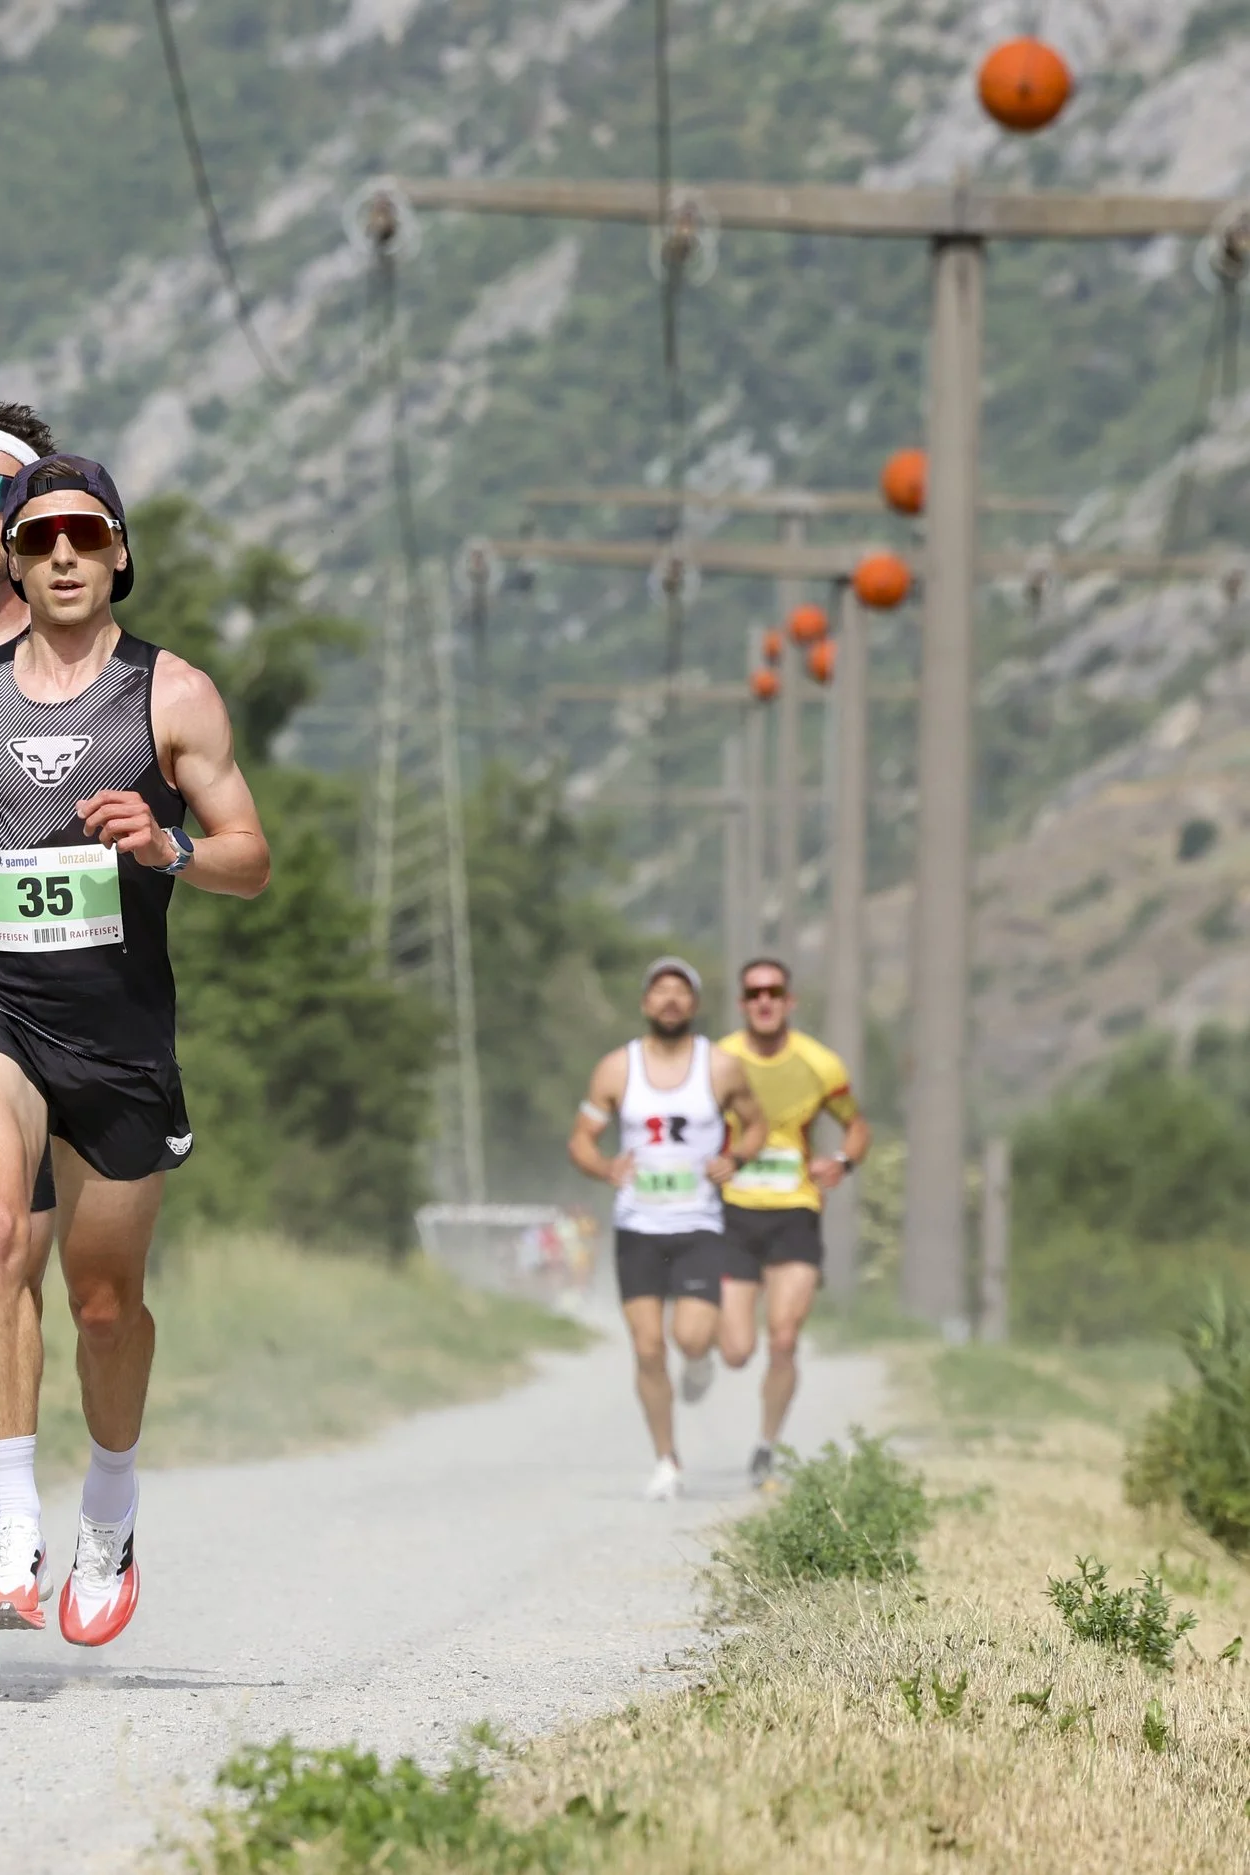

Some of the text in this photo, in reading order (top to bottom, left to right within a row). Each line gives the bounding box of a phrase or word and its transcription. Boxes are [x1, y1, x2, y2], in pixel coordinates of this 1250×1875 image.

[5, 856, 38, 868] gampel
[58, 851, 104, 865] lonzalauf
[17, 876, 73, 918] 35
[70, 925, 119, 939] RAIFFEISEN
